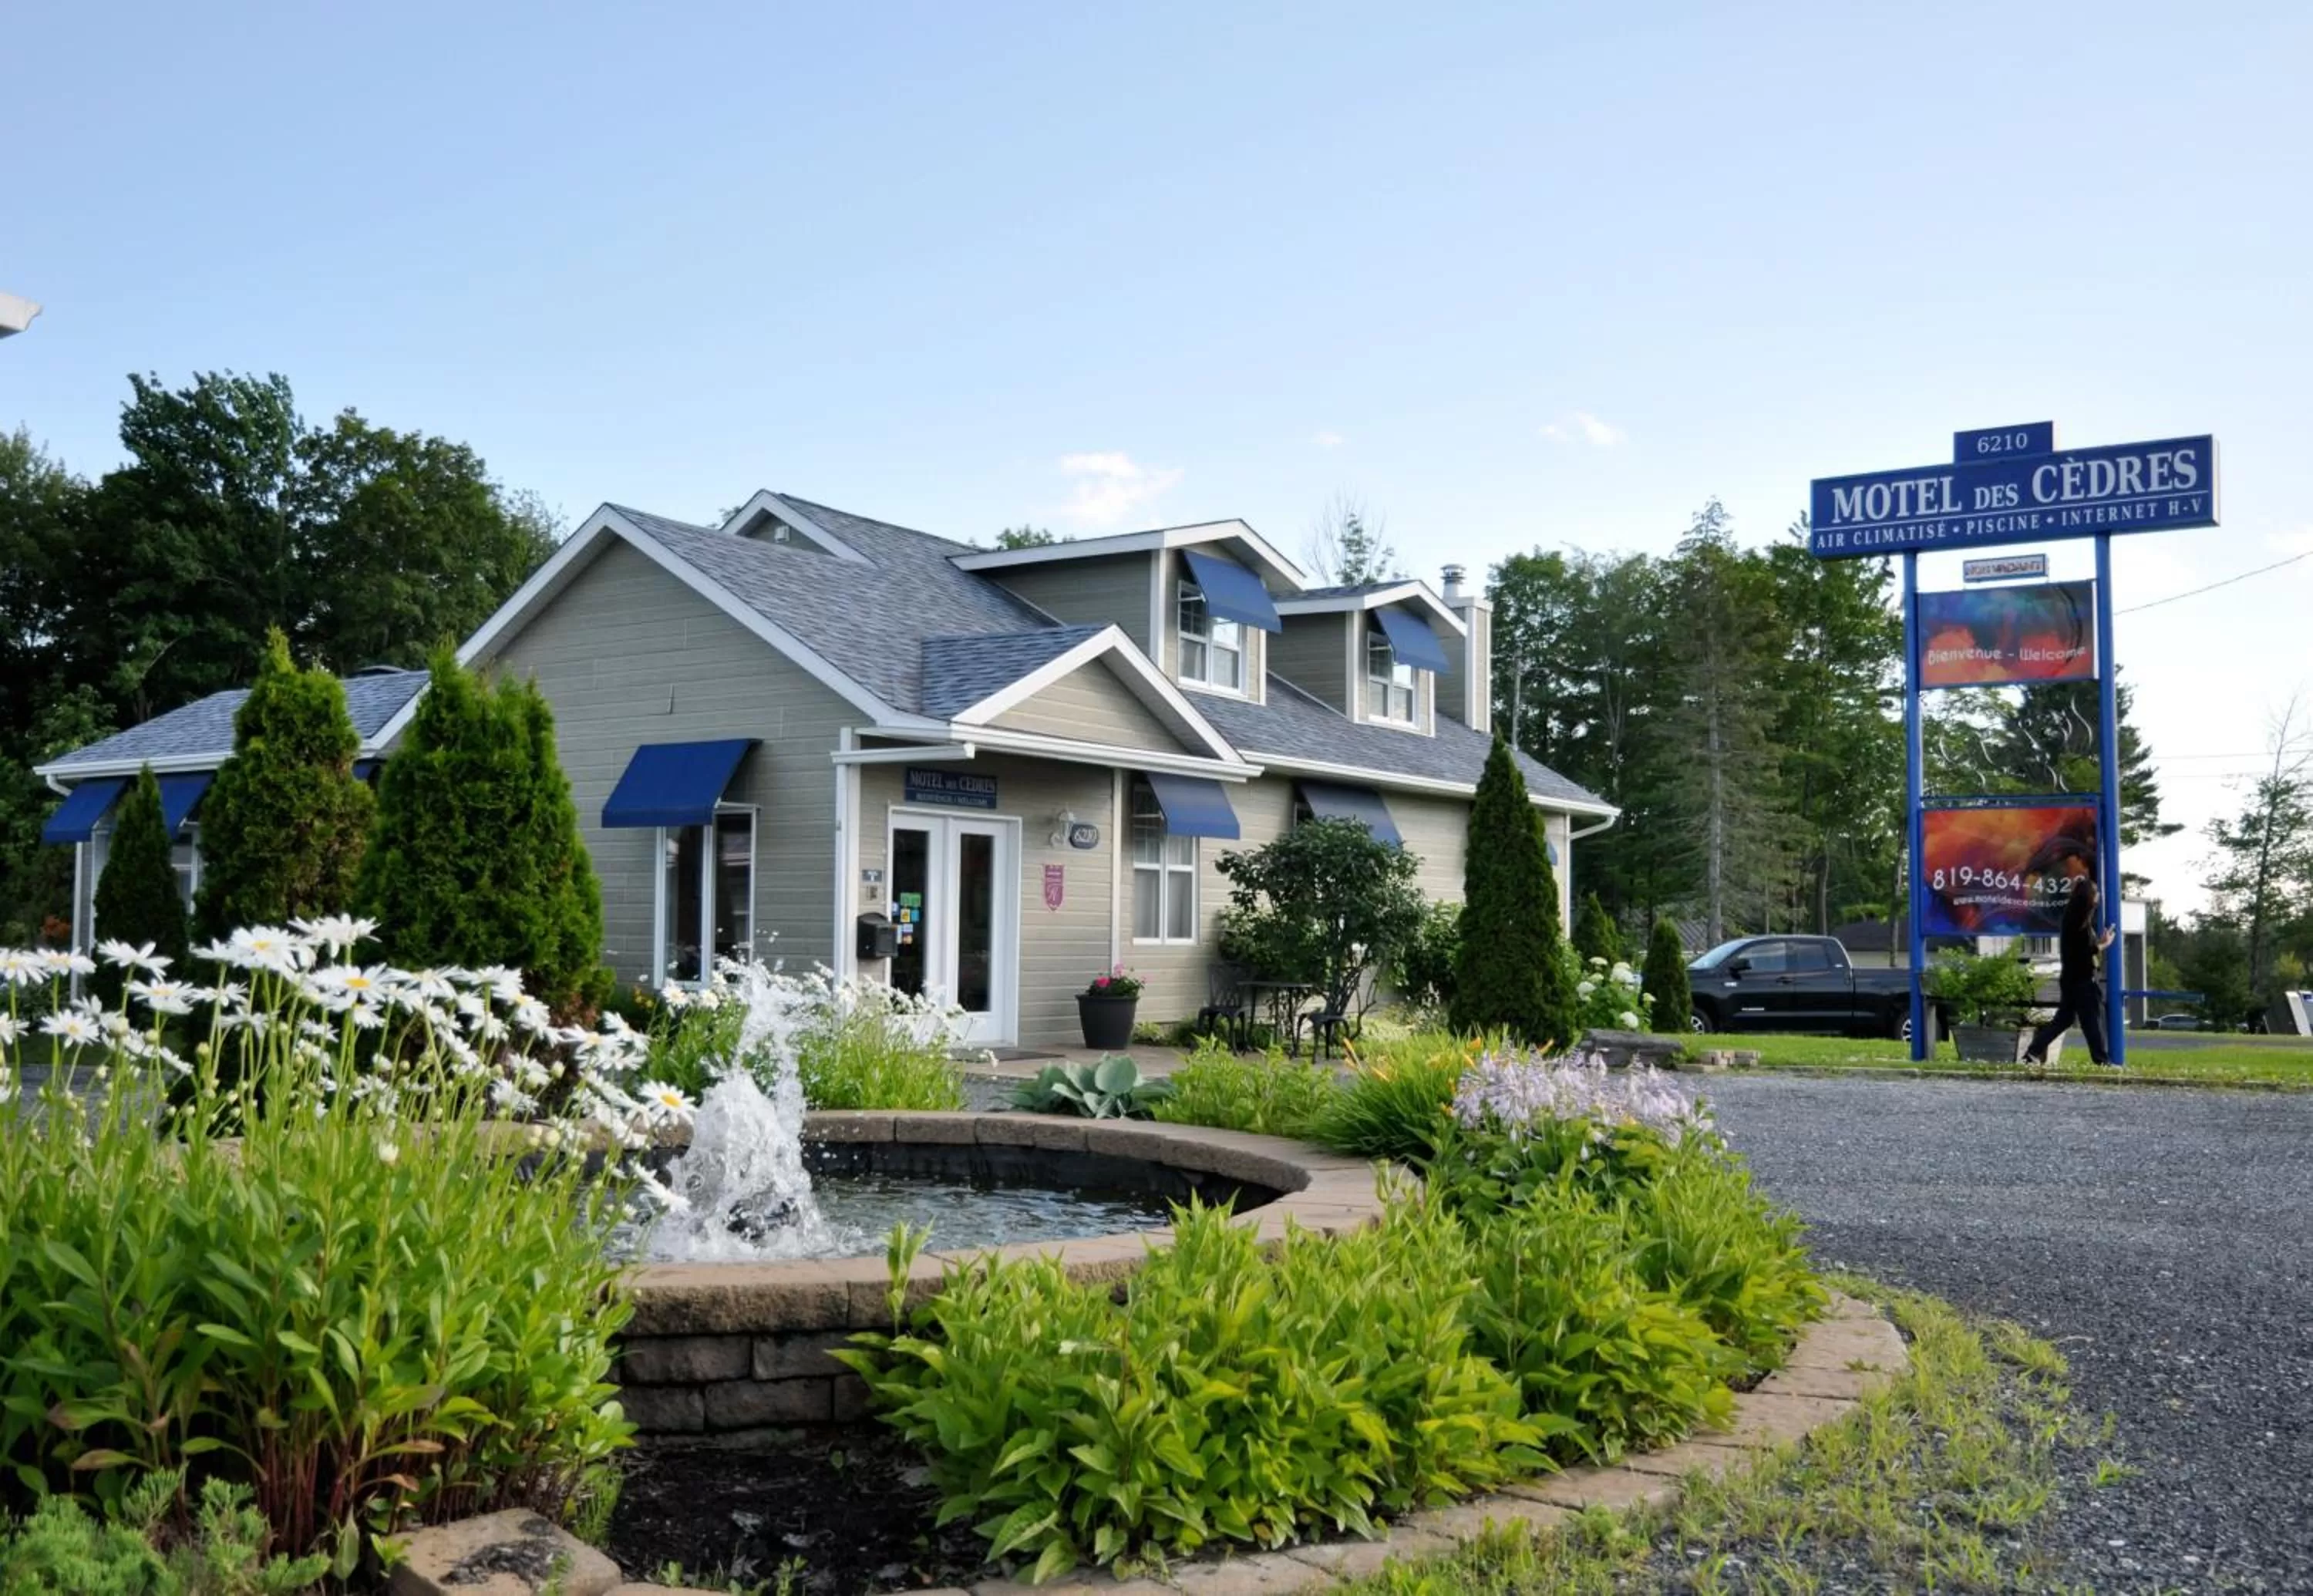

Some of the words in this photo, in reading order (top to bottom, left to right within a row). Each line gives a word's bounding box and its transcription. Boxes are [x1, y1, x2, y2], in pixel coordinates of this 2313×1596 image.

[1977, 433, 2029, 453] 6210
[1831, 476, 1962, 524] MOTEL
[1974, 483, 2019, 510] DES
[2032, 450, 2197, 503] CÈDRES
[1816, 532, 1845, 549] AIR
[1853, 520, 1947, 546] CLIMATISÉ
[1967, 514, 2041, 535] PISCINE
[2062, 503, 2158, 526] INTERNET
[1928, 648, 2003, 666] Bienvenue
[2019, 646, 2086, 662] Welcome
[911, 770, 944, 788] MOTEL
[1933, 866, 2087, 894] 819-864-432
[1953, 894, 2070, 908] www.moteldescedres.co
